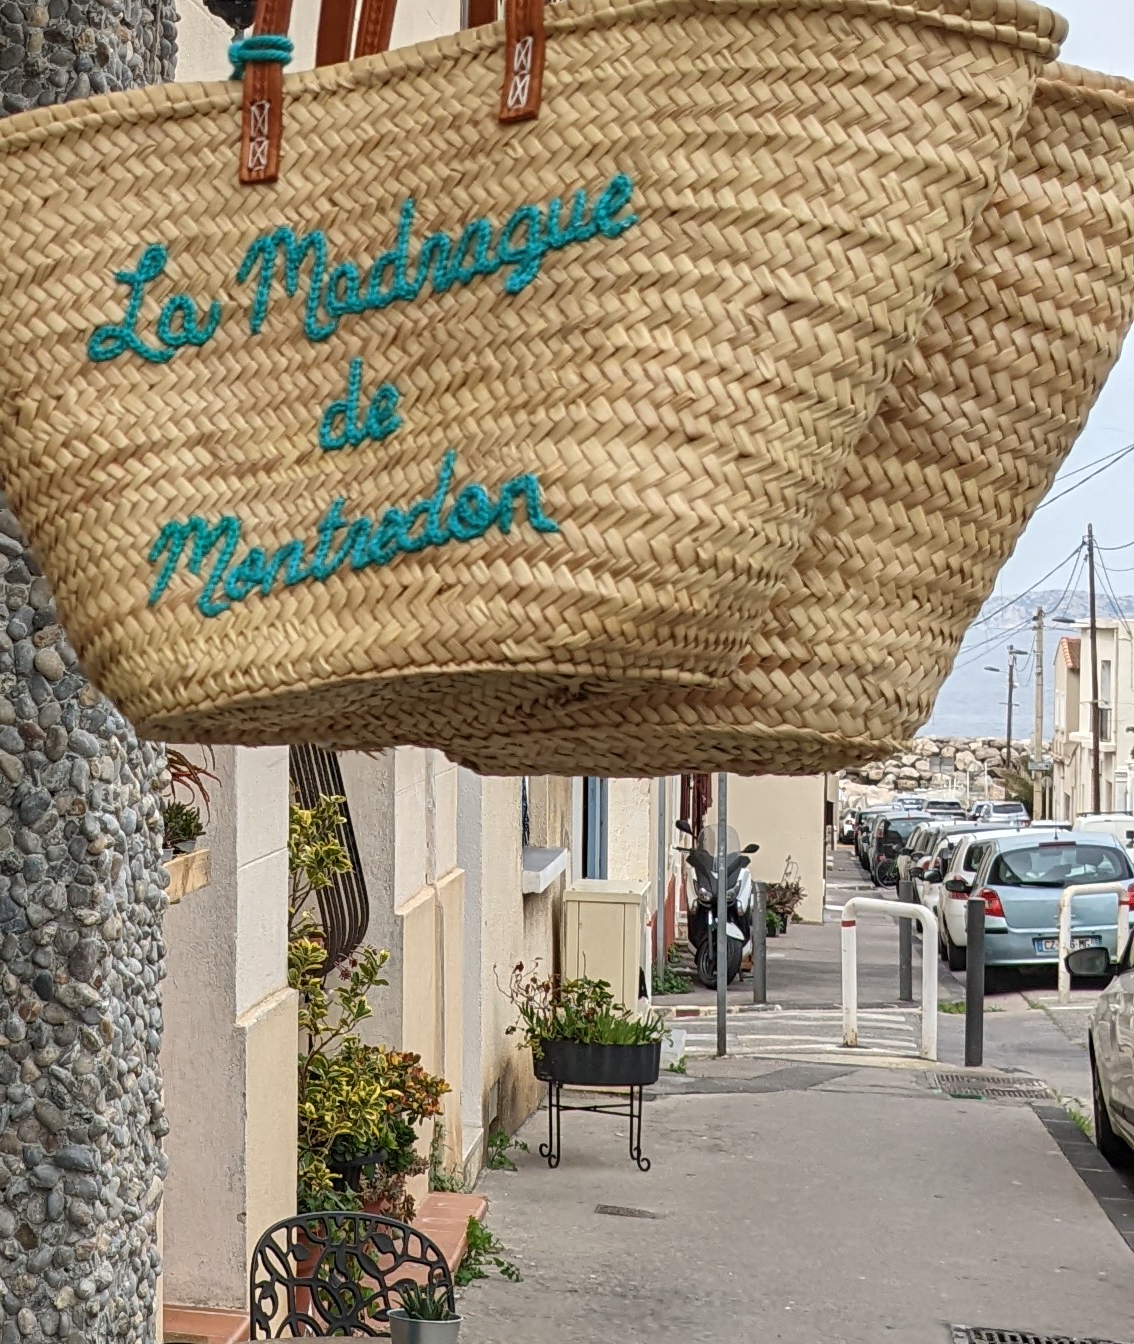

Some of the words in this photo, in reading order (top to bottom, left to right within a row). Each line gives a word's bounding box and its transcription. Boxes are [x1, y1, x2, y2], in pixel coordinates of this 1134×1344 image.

[87, 242, 222, 364] La
[236, 172, 639, 343] Madrague
[319, 356, 404, 452] de
[146, 449, 560, 619] Montredon
